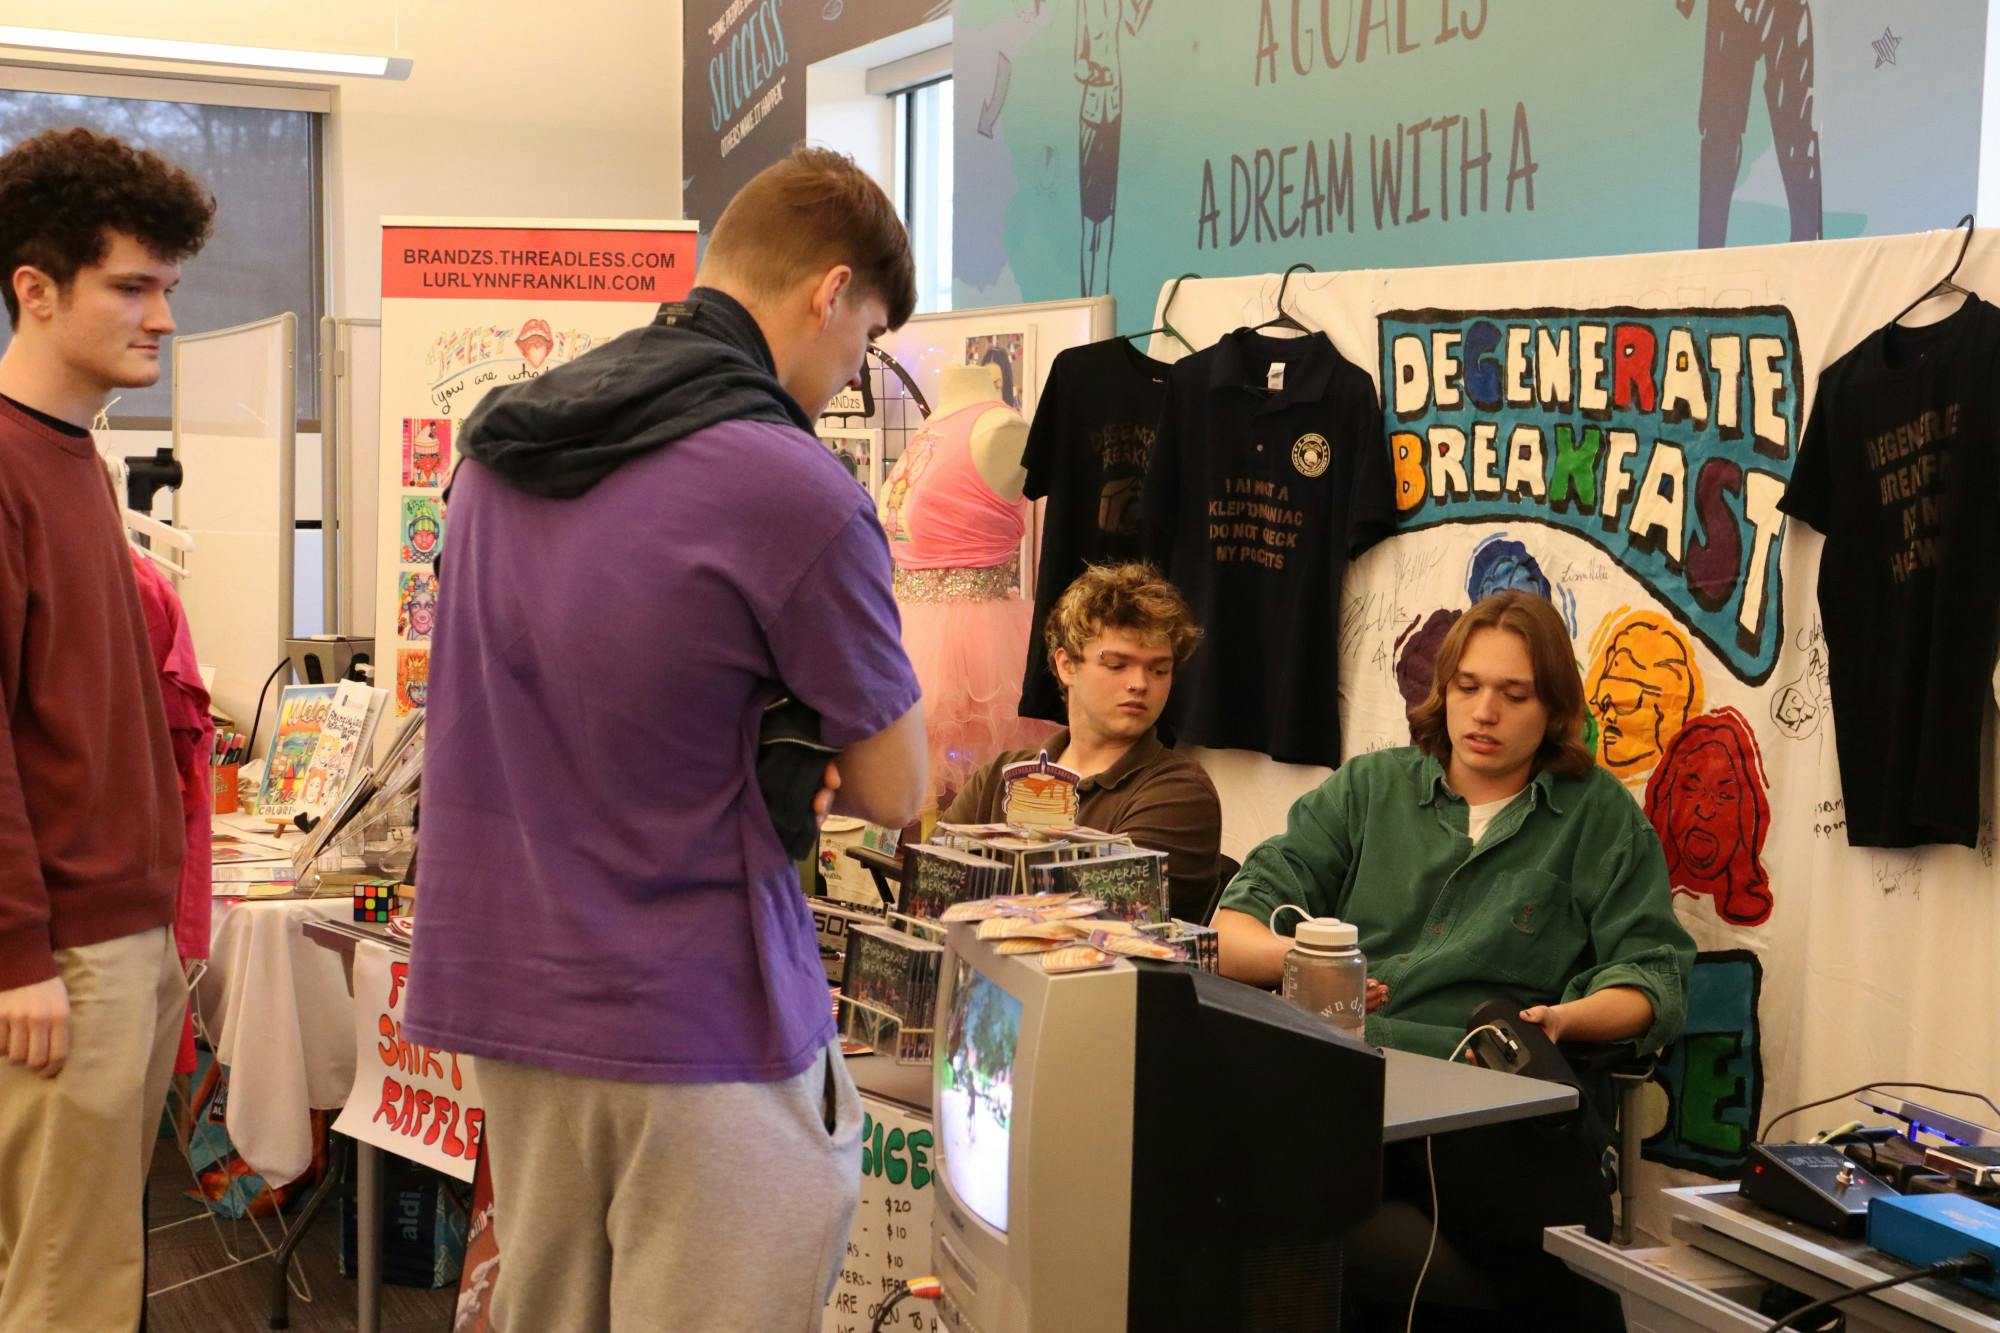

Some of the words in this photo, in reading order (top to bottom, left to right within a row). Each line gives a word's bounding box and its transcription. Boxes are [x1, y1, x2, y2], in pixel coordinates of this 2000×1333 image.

[1255, 0, 1279, 86] A
[1197, 158, 1221, 250] A
[1229, 132, 1355, 247] DREAM
[1370, 108, 1492, 230] WITH
[1505, 101, 1539, 213] A
[402, 249, 676, 270] BRANDZS.THREADLESS.COM
[422, 271, 656, 292] LURLYNNFRANKLIN.COM
[1391, 320, 1790, 460] DEGENERATE
[1208, 523, 1230, 540] DO
[1389, 423, 1789, 657] BREAKFAST
[388, 961, 409, 1008] F
[373, 1075, 485, 1160] RAFFLE
[885, 1197, 911, 1216] $20
[887, 1223, 907, 1240] $10
[887, 1251, 904, 1269] $10
[835, 1293, 858, 1314] ARE
